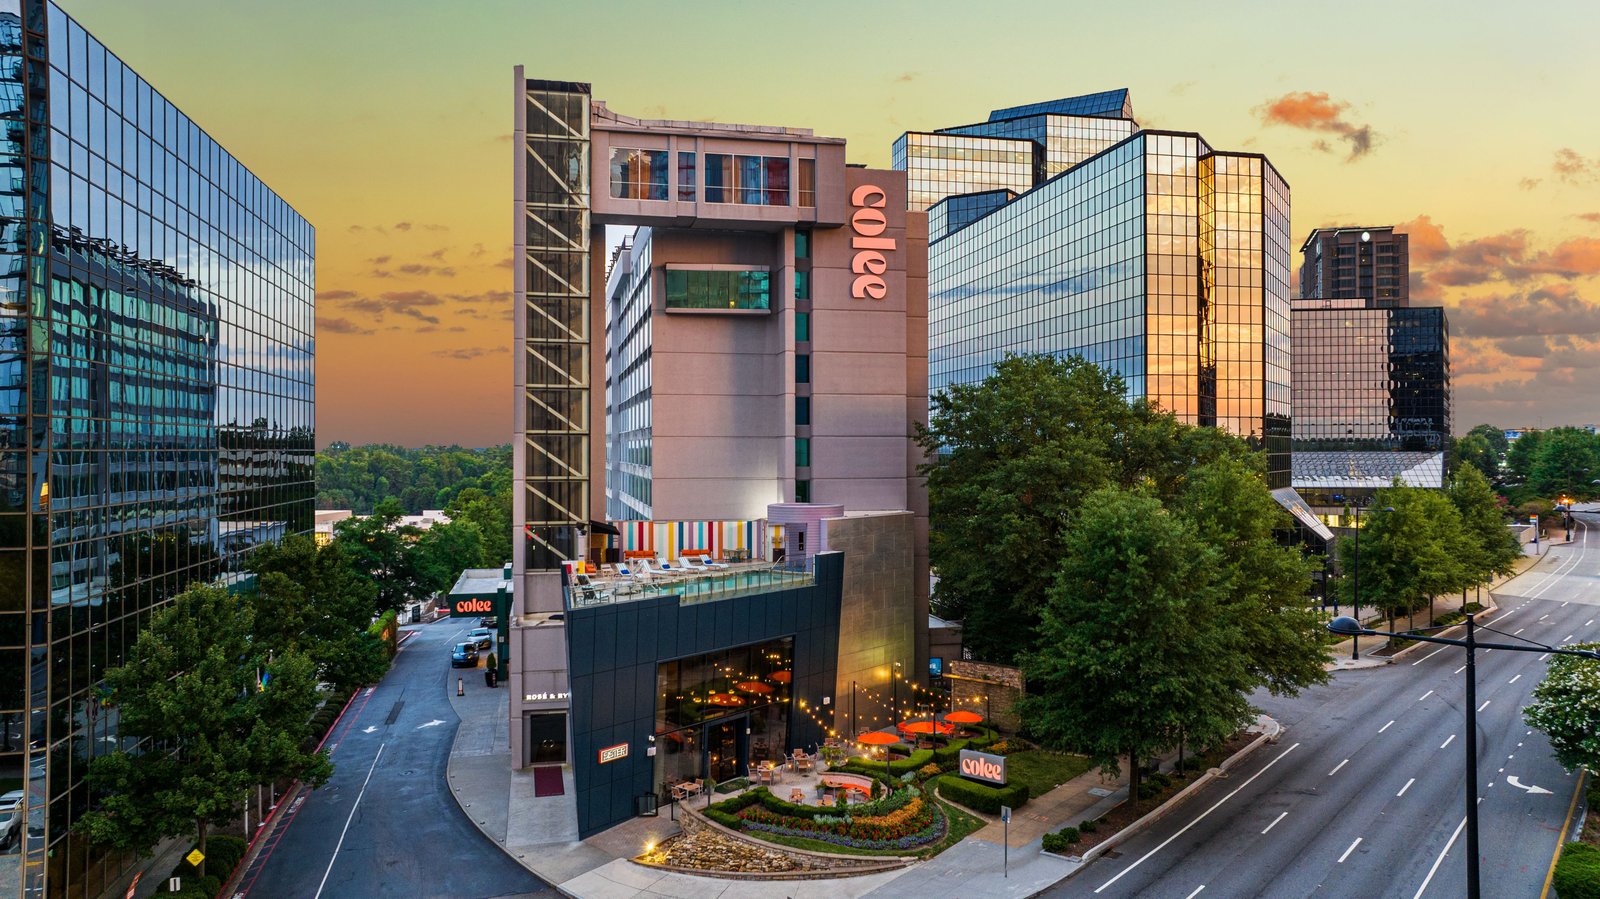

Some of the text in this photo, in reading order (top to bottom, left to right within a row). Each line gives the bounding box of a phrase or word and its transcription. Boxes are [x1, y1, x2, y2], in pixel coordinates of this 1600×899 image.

[852, 184, 896, 299] colee
[456, 598, 492, 613] colee
[962, 757, 1002, 781] colee
